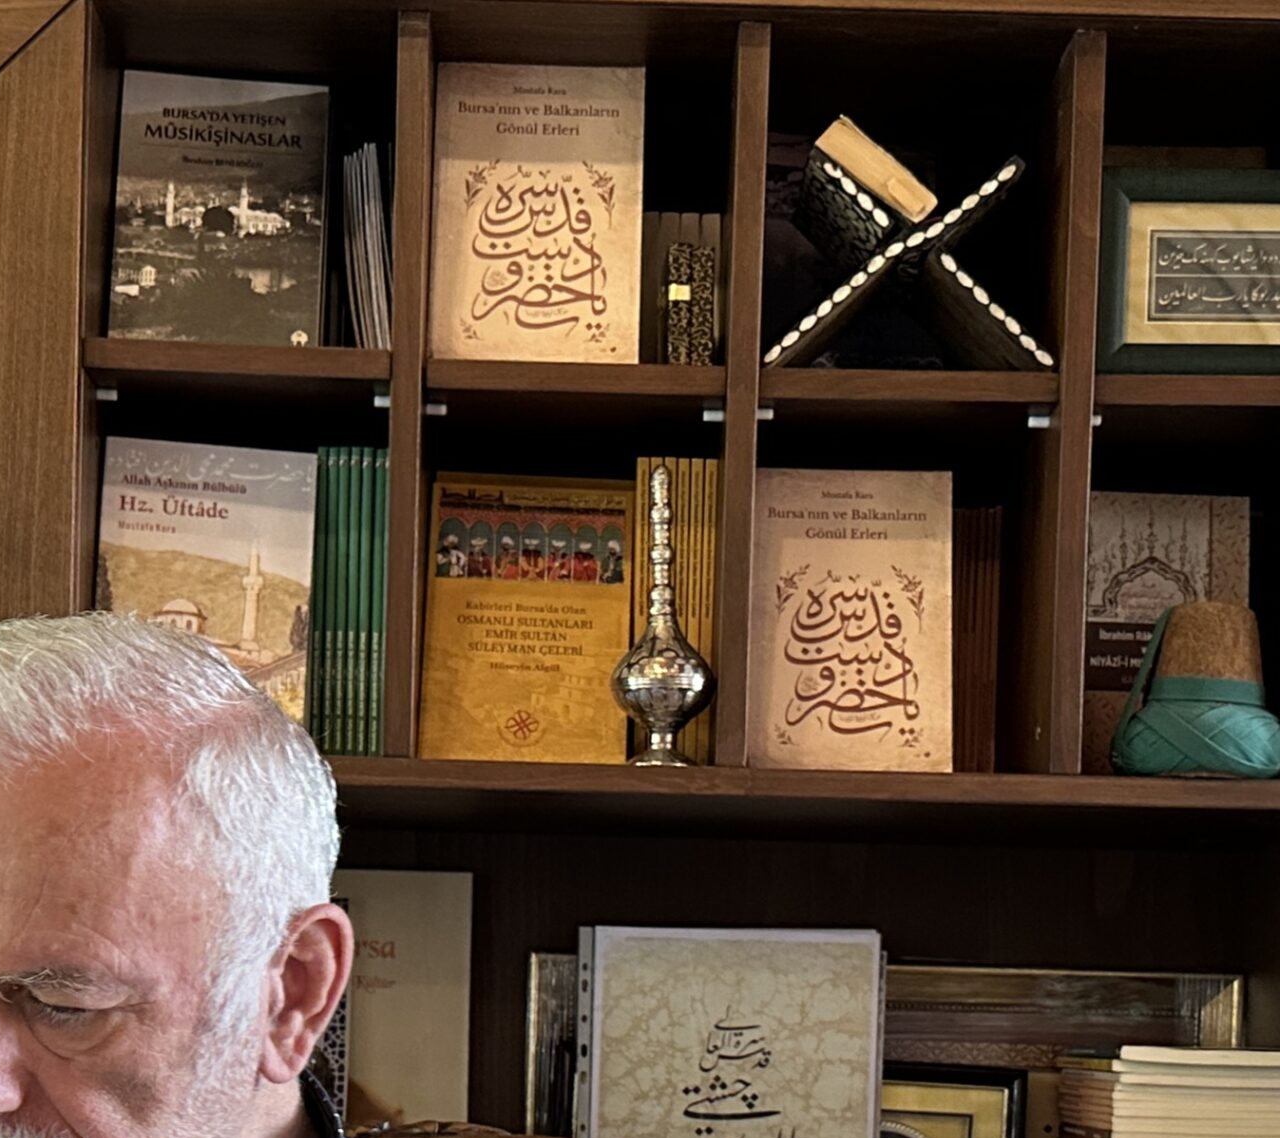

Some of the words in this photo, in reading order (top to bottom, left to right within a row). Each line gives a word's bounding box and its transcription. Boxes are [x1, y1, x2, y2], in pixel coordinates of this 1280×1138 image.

[162, 107, 230, 124] BURSA'DA
[232, 112, 287, 127] YETİŞEN
[524, 106, 540, 115] ve
[543, 104, 620, 118] Balkanların
[542, 123, 580, 136] Erleri
[120, 474, 152, 487] Allah
[118, 494, 153, 514] Hz.
[162, 495, 230, 520] Üftâde
[833, 511, 848, 520] ve
[851, 509, 927, 523] Balkanların
[851, 528, 889, 540] Erleri
[561, 604, 587, 615] Olan
[457, 614, 514, 627] OSMANLI
[517, 616, 593, 630] SULTANLARI
[521, 630, 567, 642] SULTAN
[468, 641, 536, 654] SÜLEYMAN
